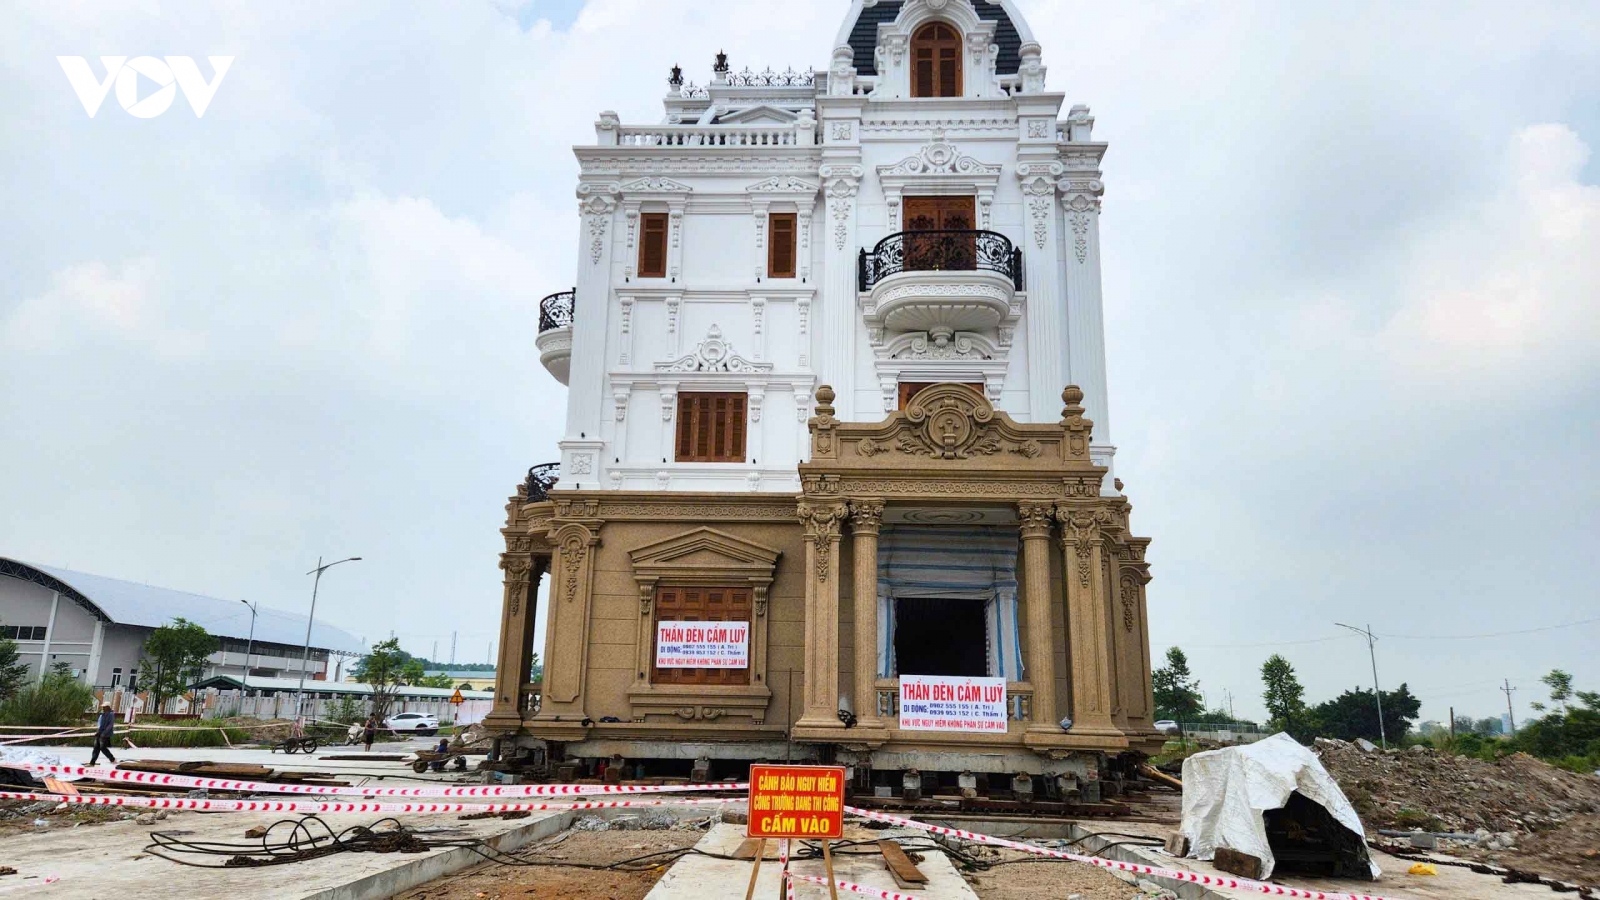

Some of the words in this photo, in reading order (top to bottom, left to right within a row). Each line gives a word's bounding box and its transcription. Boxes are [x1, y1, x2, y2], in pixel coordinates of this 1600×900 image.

[759, 771, 778, 790] CẢNH
[780, 773, 795, 791] BÁO
[797, 776, 816, 791] NGUY
[818, 772, 836, 792] HIỂM
[754, 792, 770, 810] CÔNG
[813, 796, 822, 811] THI
[823, 794, 839, 812] CÔNG
[762, 813, 796, 833] CẤM
[801, 815, 829, 833] VÀO
